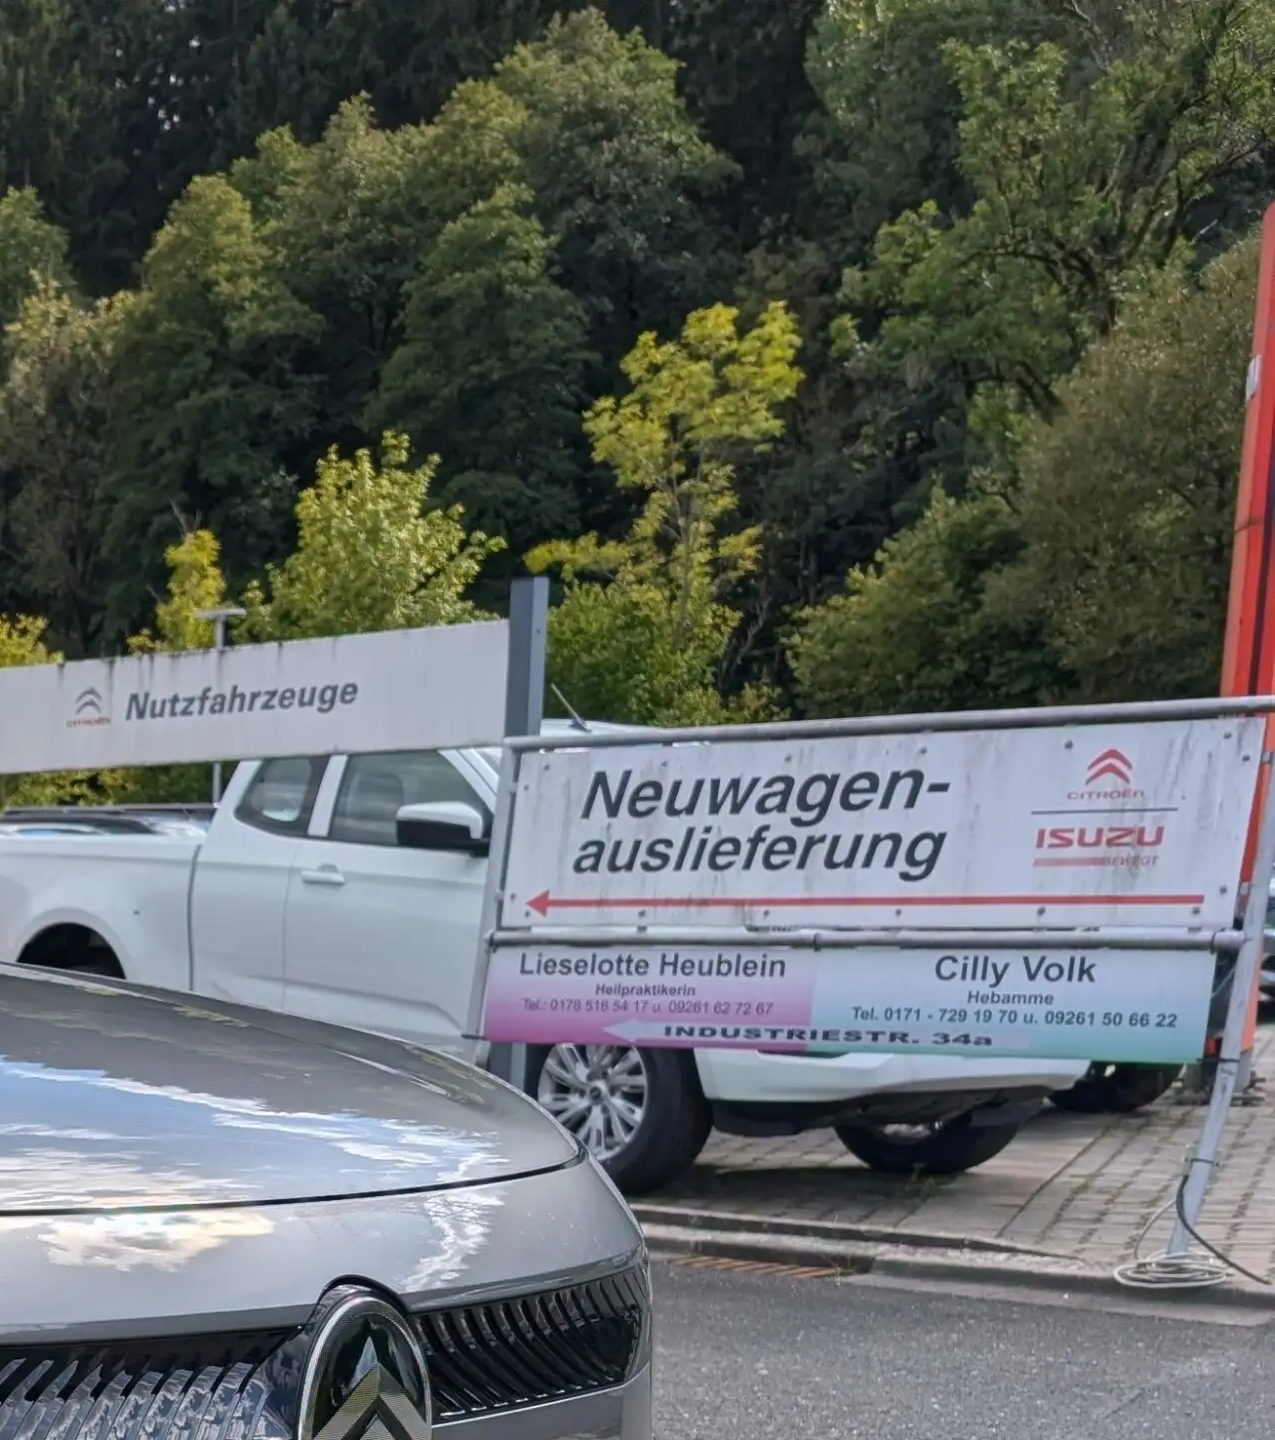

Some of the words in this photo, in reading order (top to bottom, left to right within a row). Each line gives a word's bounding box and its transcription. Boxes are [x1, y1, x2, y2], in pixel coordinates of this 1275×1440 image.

[125, 681, 359, 722] Nutzfahrzeuge
[580, 769, 951, 828] Neuwagen-
[1035, 826, 1165, 849] ISUZU
[572, 824, 948, 882] auslieferung
[519, 952, 650, 977] Lieselotte
[658, 953, 786, 978] Heublein
[934, 955, 1010, 988] Cilly
[1022, 956, 1097, 983] Volk
[595, 983, 696, 997] Heilpraktikerin
[967, 990, 1055, 1005] Hebamme
[550, 1000, 582, 1012] 0178
[635, 1001, 648, 1013] 17
[668, 1002, 709, 1014] 09261
[756, 1003, 774, 1015] 67
[852, 1007, 879, 1022] Tel.
[884, 1007, 921, 1022] 0171
[938, 1008, 968, 1024] 729
[973, 1009, 992, 1024] 19
[998, 1009, 1018, 1025] 70
[1023, 1013, 1038, 1025] u.
[1044, 1010, 1095, 1026] 09261
[1102, 1011, 1123, 1027] 50
[1128, 1012, 1150, 1028] 66
[1155, 1013, 1178, 1029] 22
[663, 1026, 919, 1044] INDUSTRIESTR.
[932, 1032, 993, 1046] 34a
